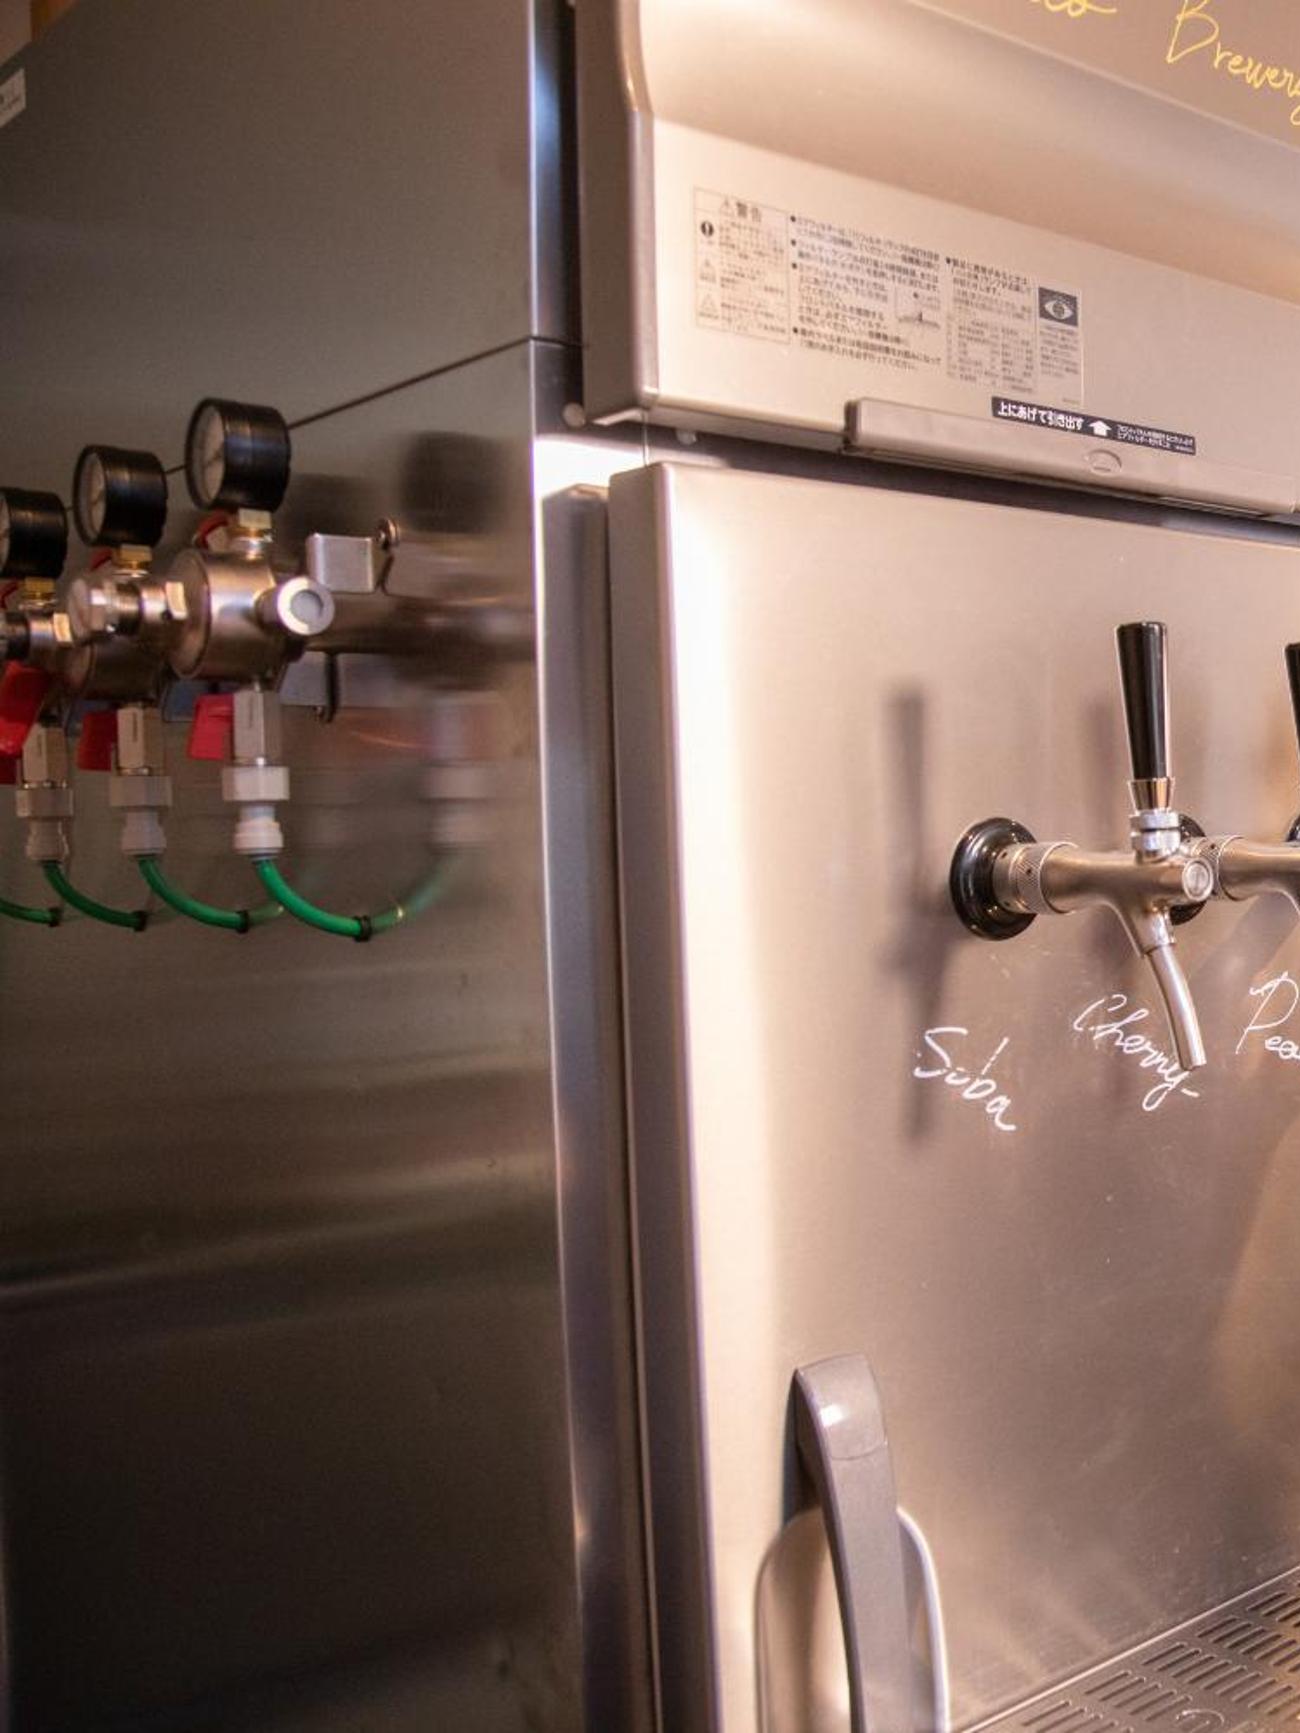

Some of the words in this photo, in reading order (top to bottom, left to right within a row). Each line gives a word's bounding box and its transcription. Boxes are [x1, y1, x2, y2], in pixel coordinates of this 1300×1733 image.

[997, 401, 1085, 431] 上にあげて引き出す
[1073, 993, 1200, 1111] Cherry
